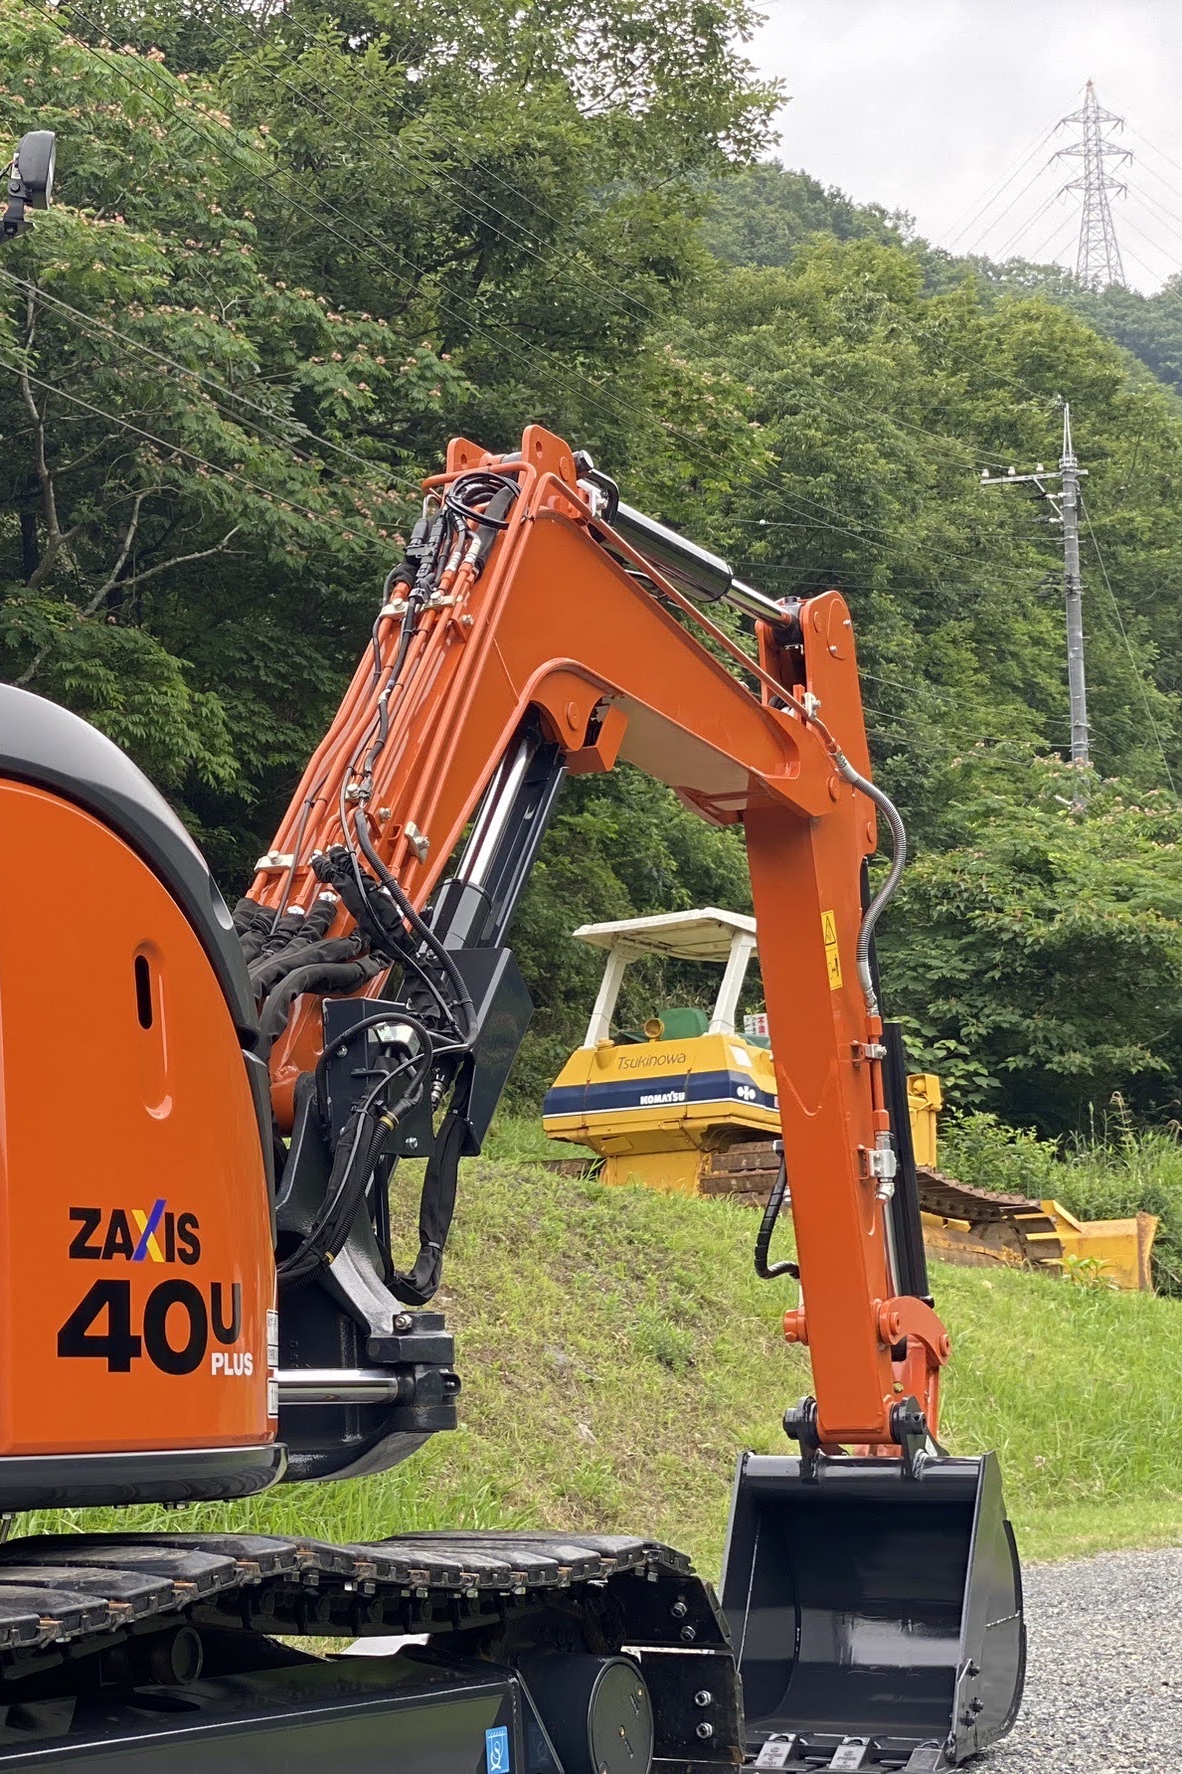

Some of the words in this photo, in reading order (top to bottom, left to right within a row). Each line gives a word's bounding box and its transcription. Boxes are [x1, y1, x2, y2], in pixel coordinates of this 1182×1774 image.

[618, 1052, 687, 1070] Tsukinowa
[640, 1090, 685, 1105] KOMATSU
[69, 1199, 201, 1265] ZAXIS
[211, 1352, 254, 1376] PLUS
